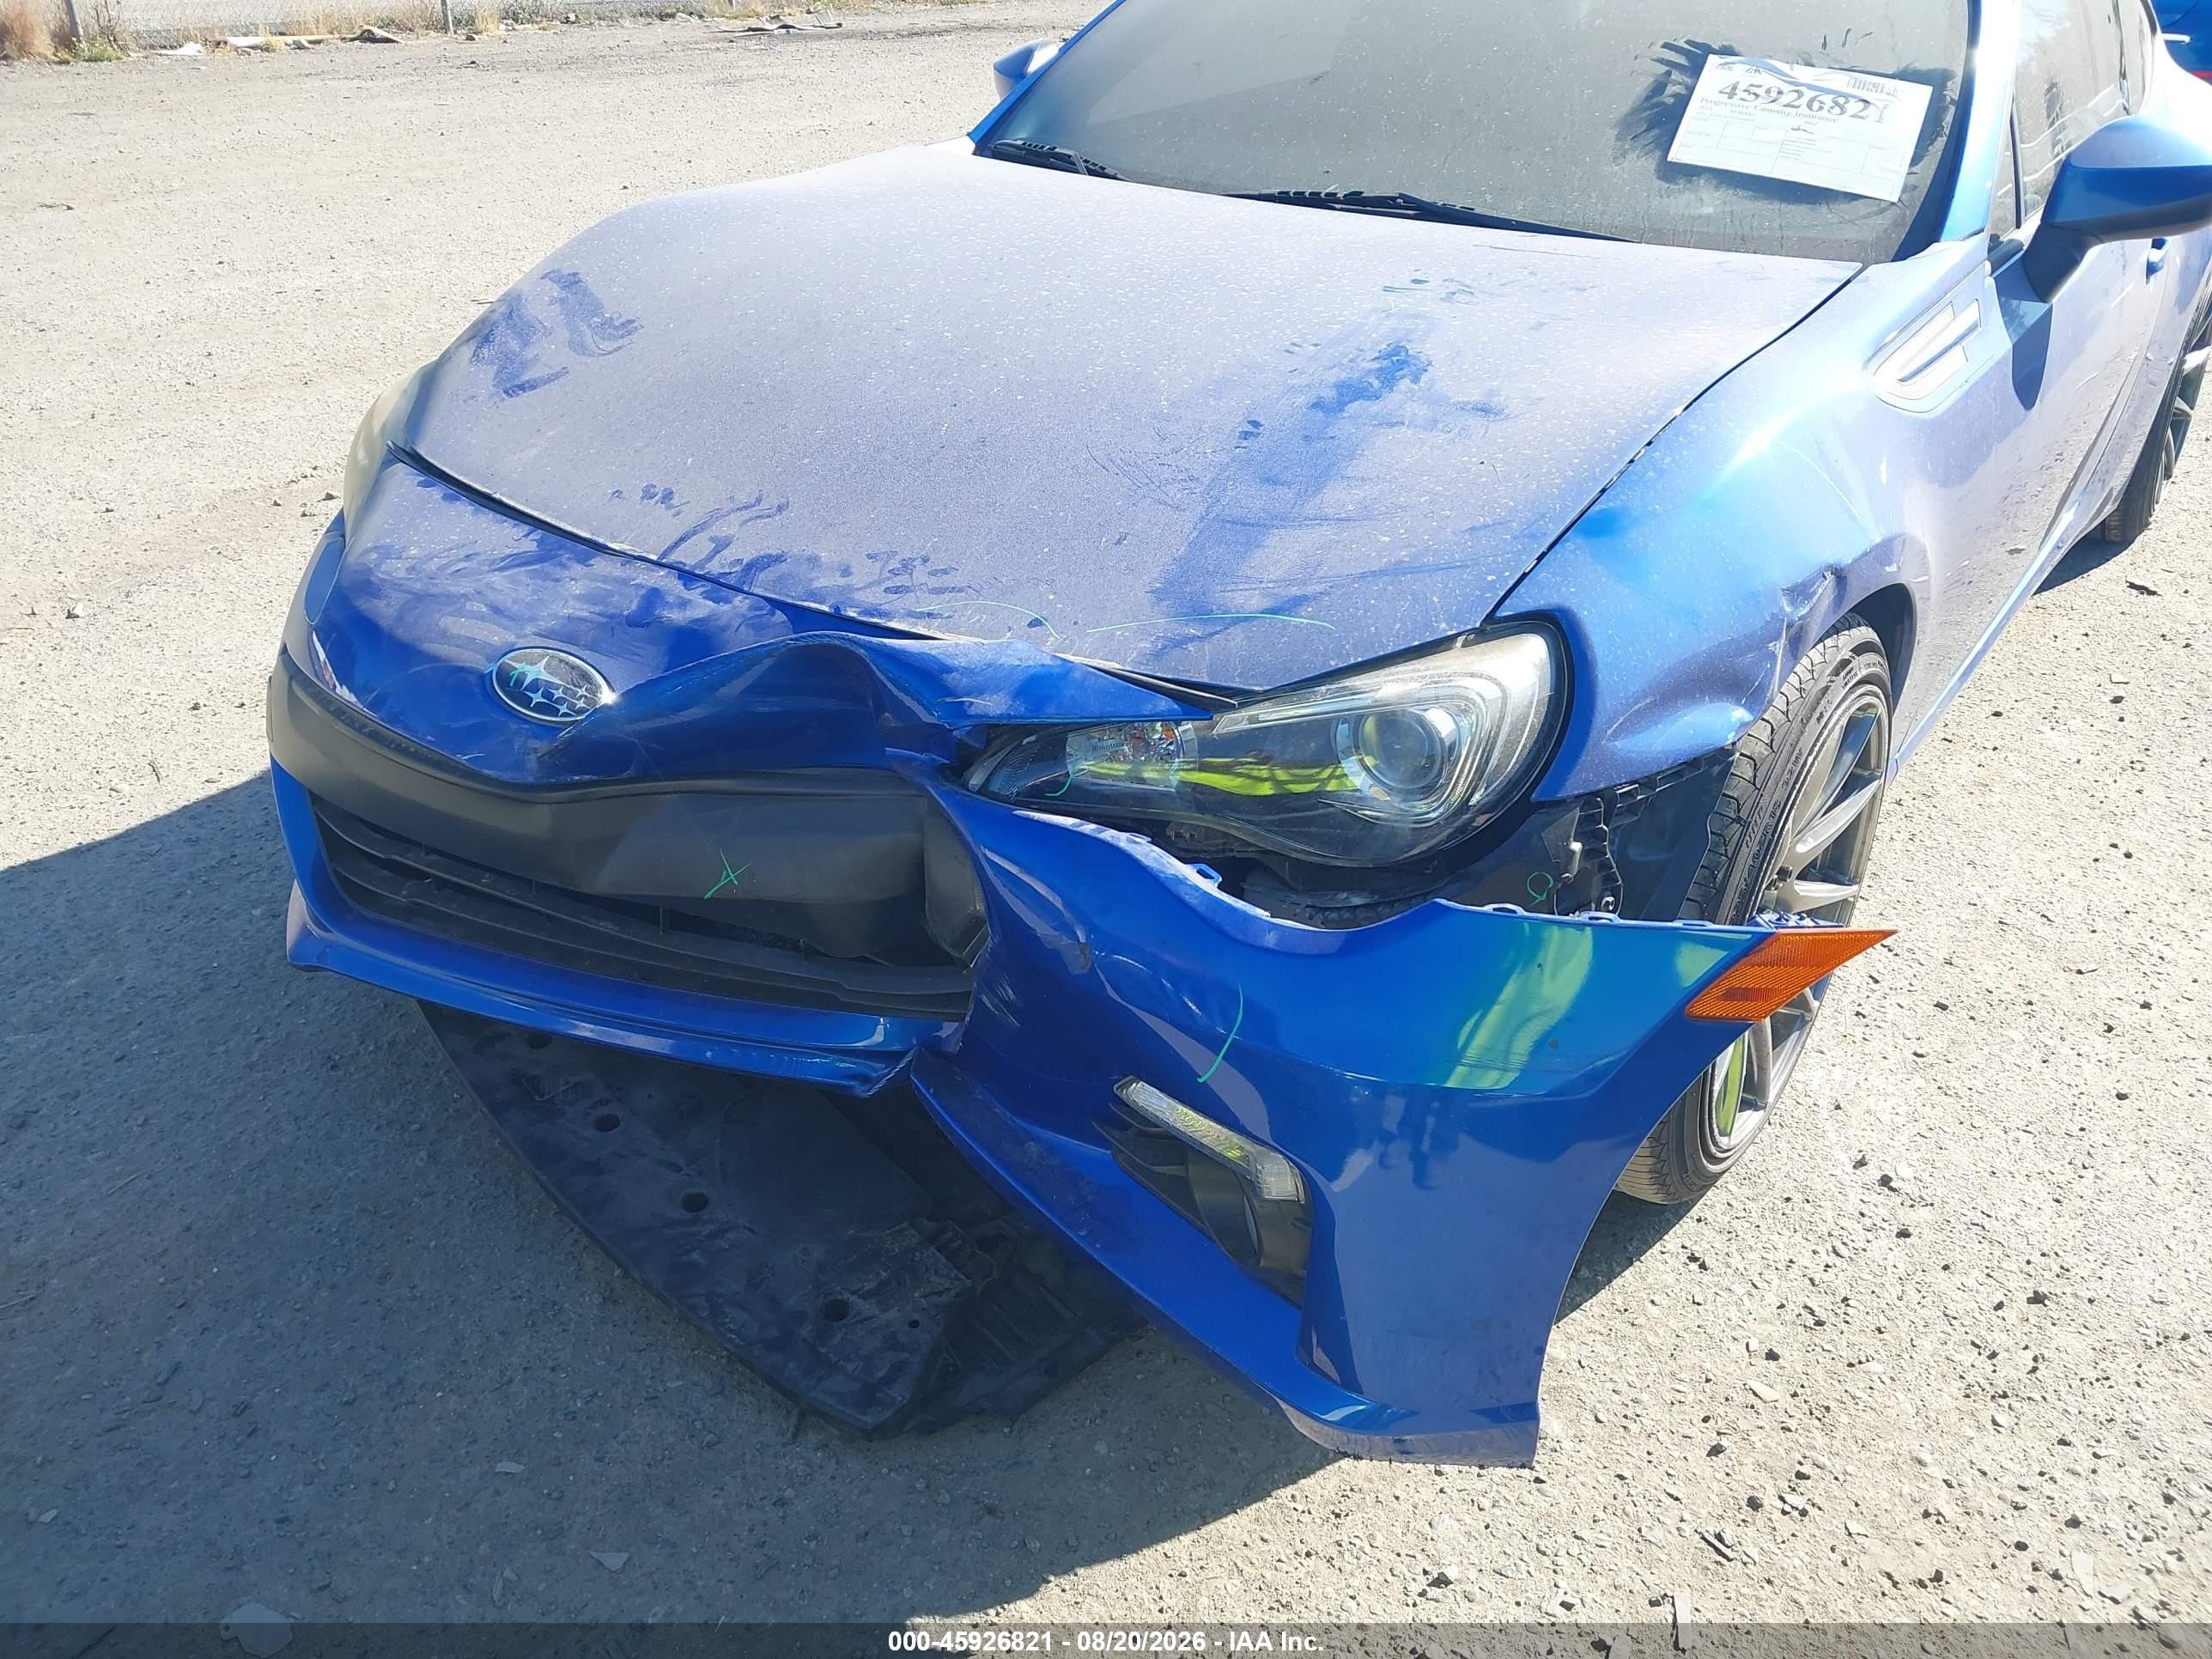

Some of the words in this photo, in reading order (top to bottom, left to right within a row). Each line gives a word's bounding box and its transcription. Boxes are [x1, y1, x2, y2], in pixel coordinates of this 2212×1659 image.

[1700, 97, 1752, 109] Progressive
[1753, 104, 1790, 117] Casualty
[1795, 111, 1839, 123] Insurance
